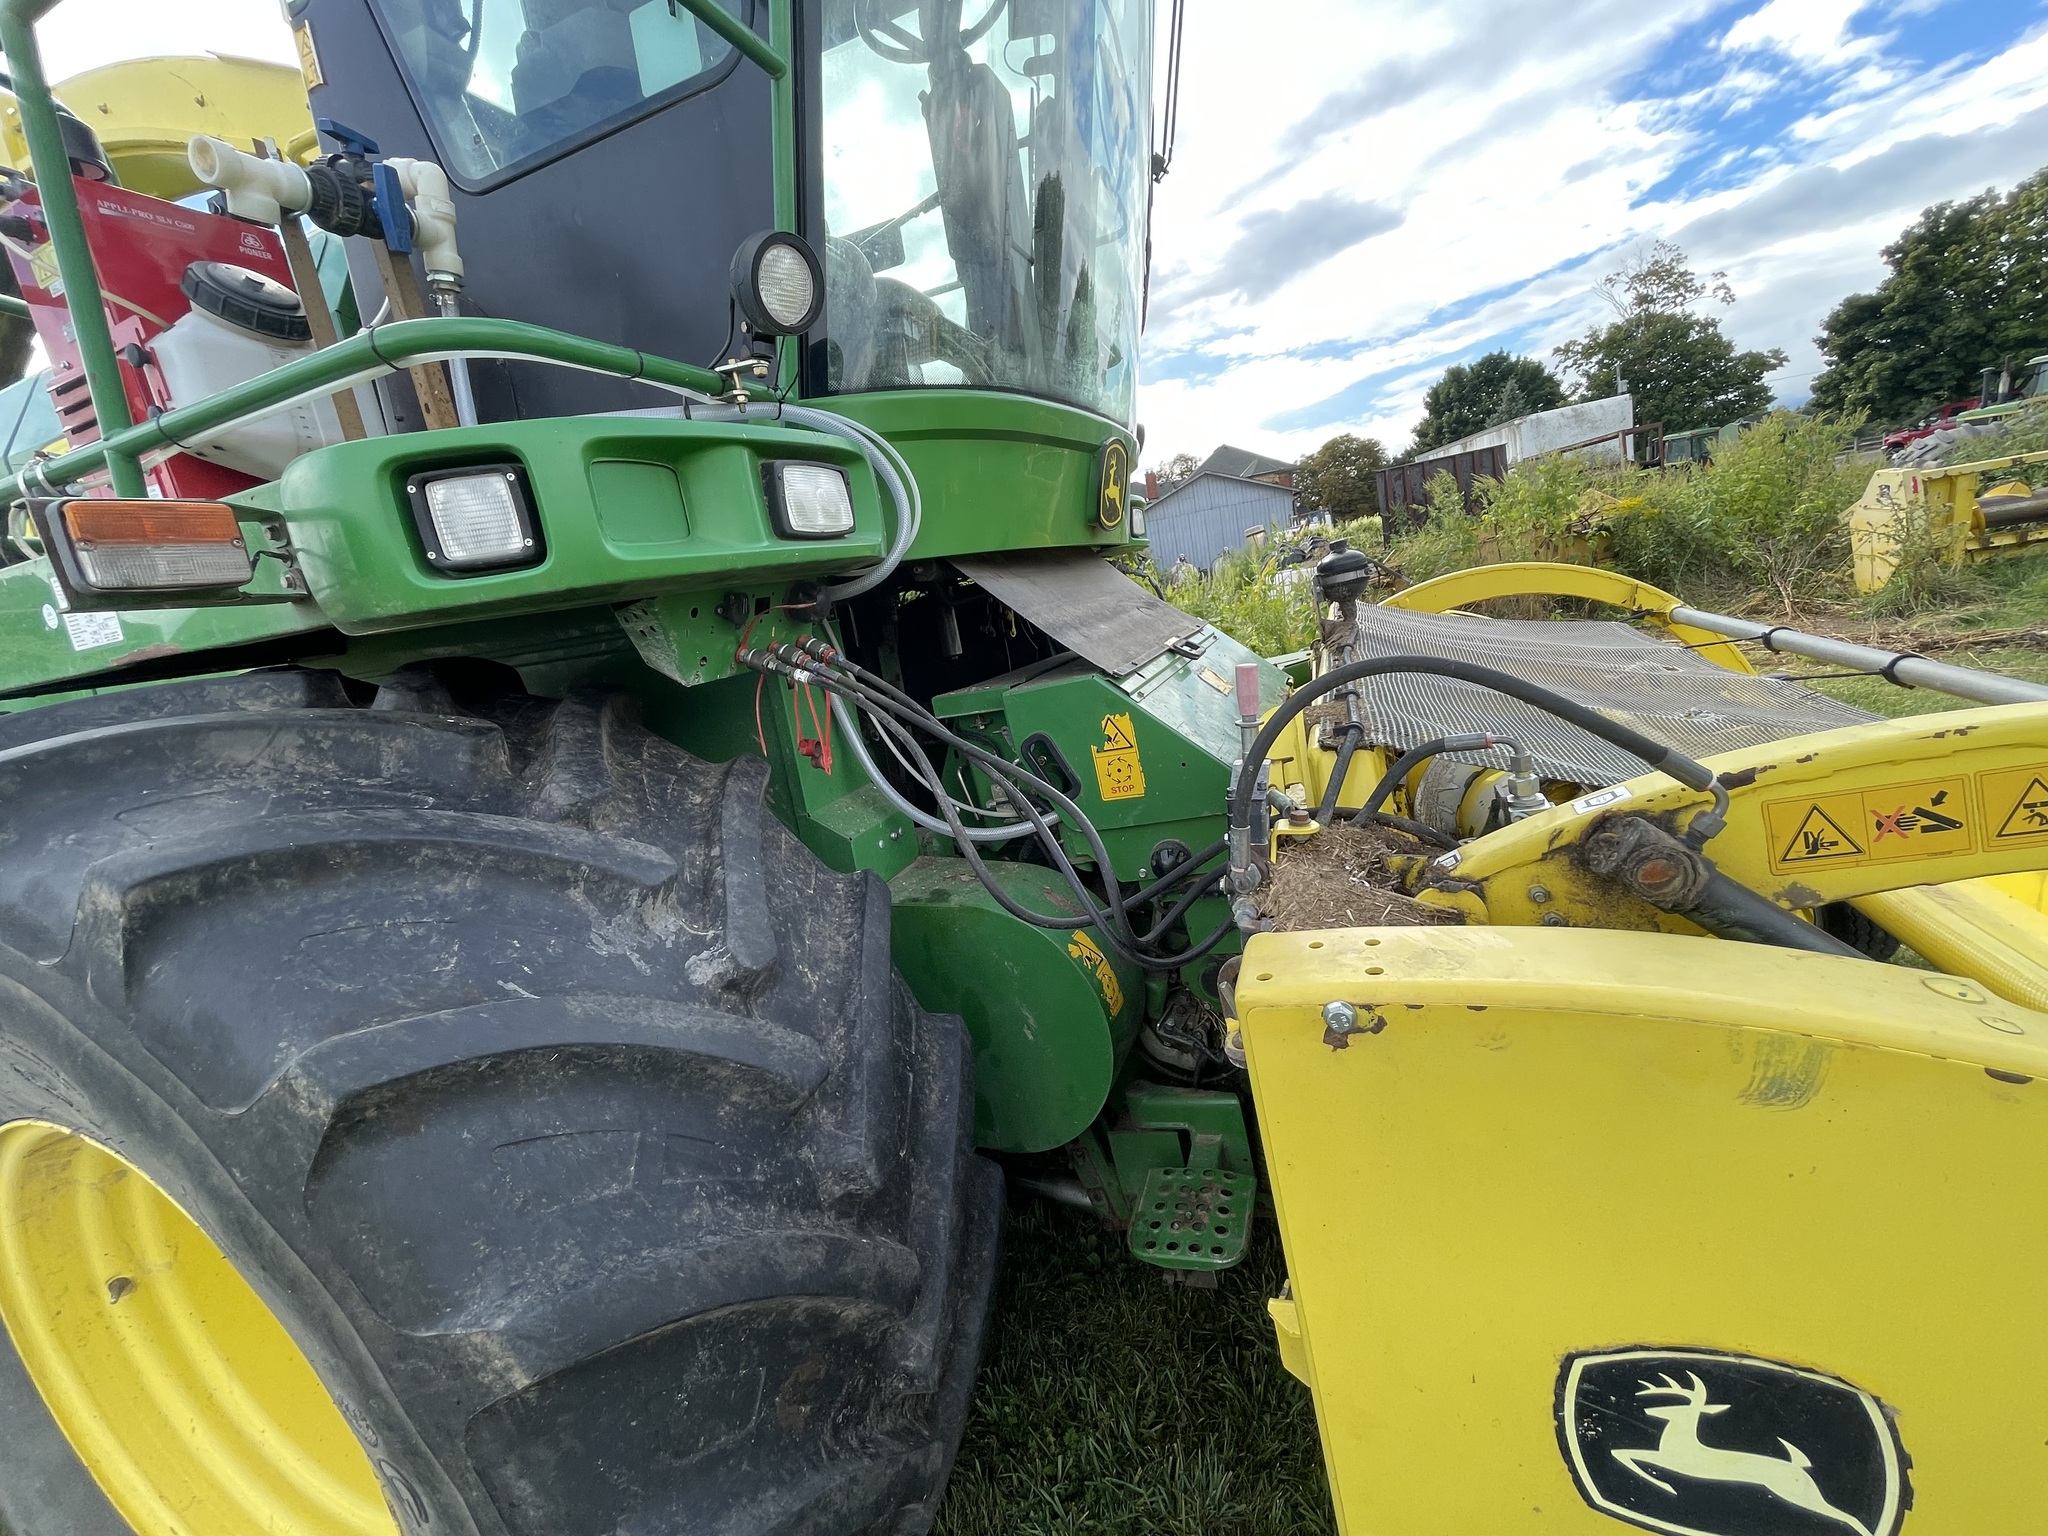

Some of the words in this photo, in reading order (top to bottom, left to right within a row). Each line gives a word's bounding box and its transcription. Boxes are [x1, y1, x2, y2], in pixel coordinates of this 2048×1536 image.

[97, 200, 154, 220] APPLI-PRO
[156, 215, 174, 225] SLV
[239, 245, 273, 260] PIONEER
[1111, 784, 1135, 795] STOP
